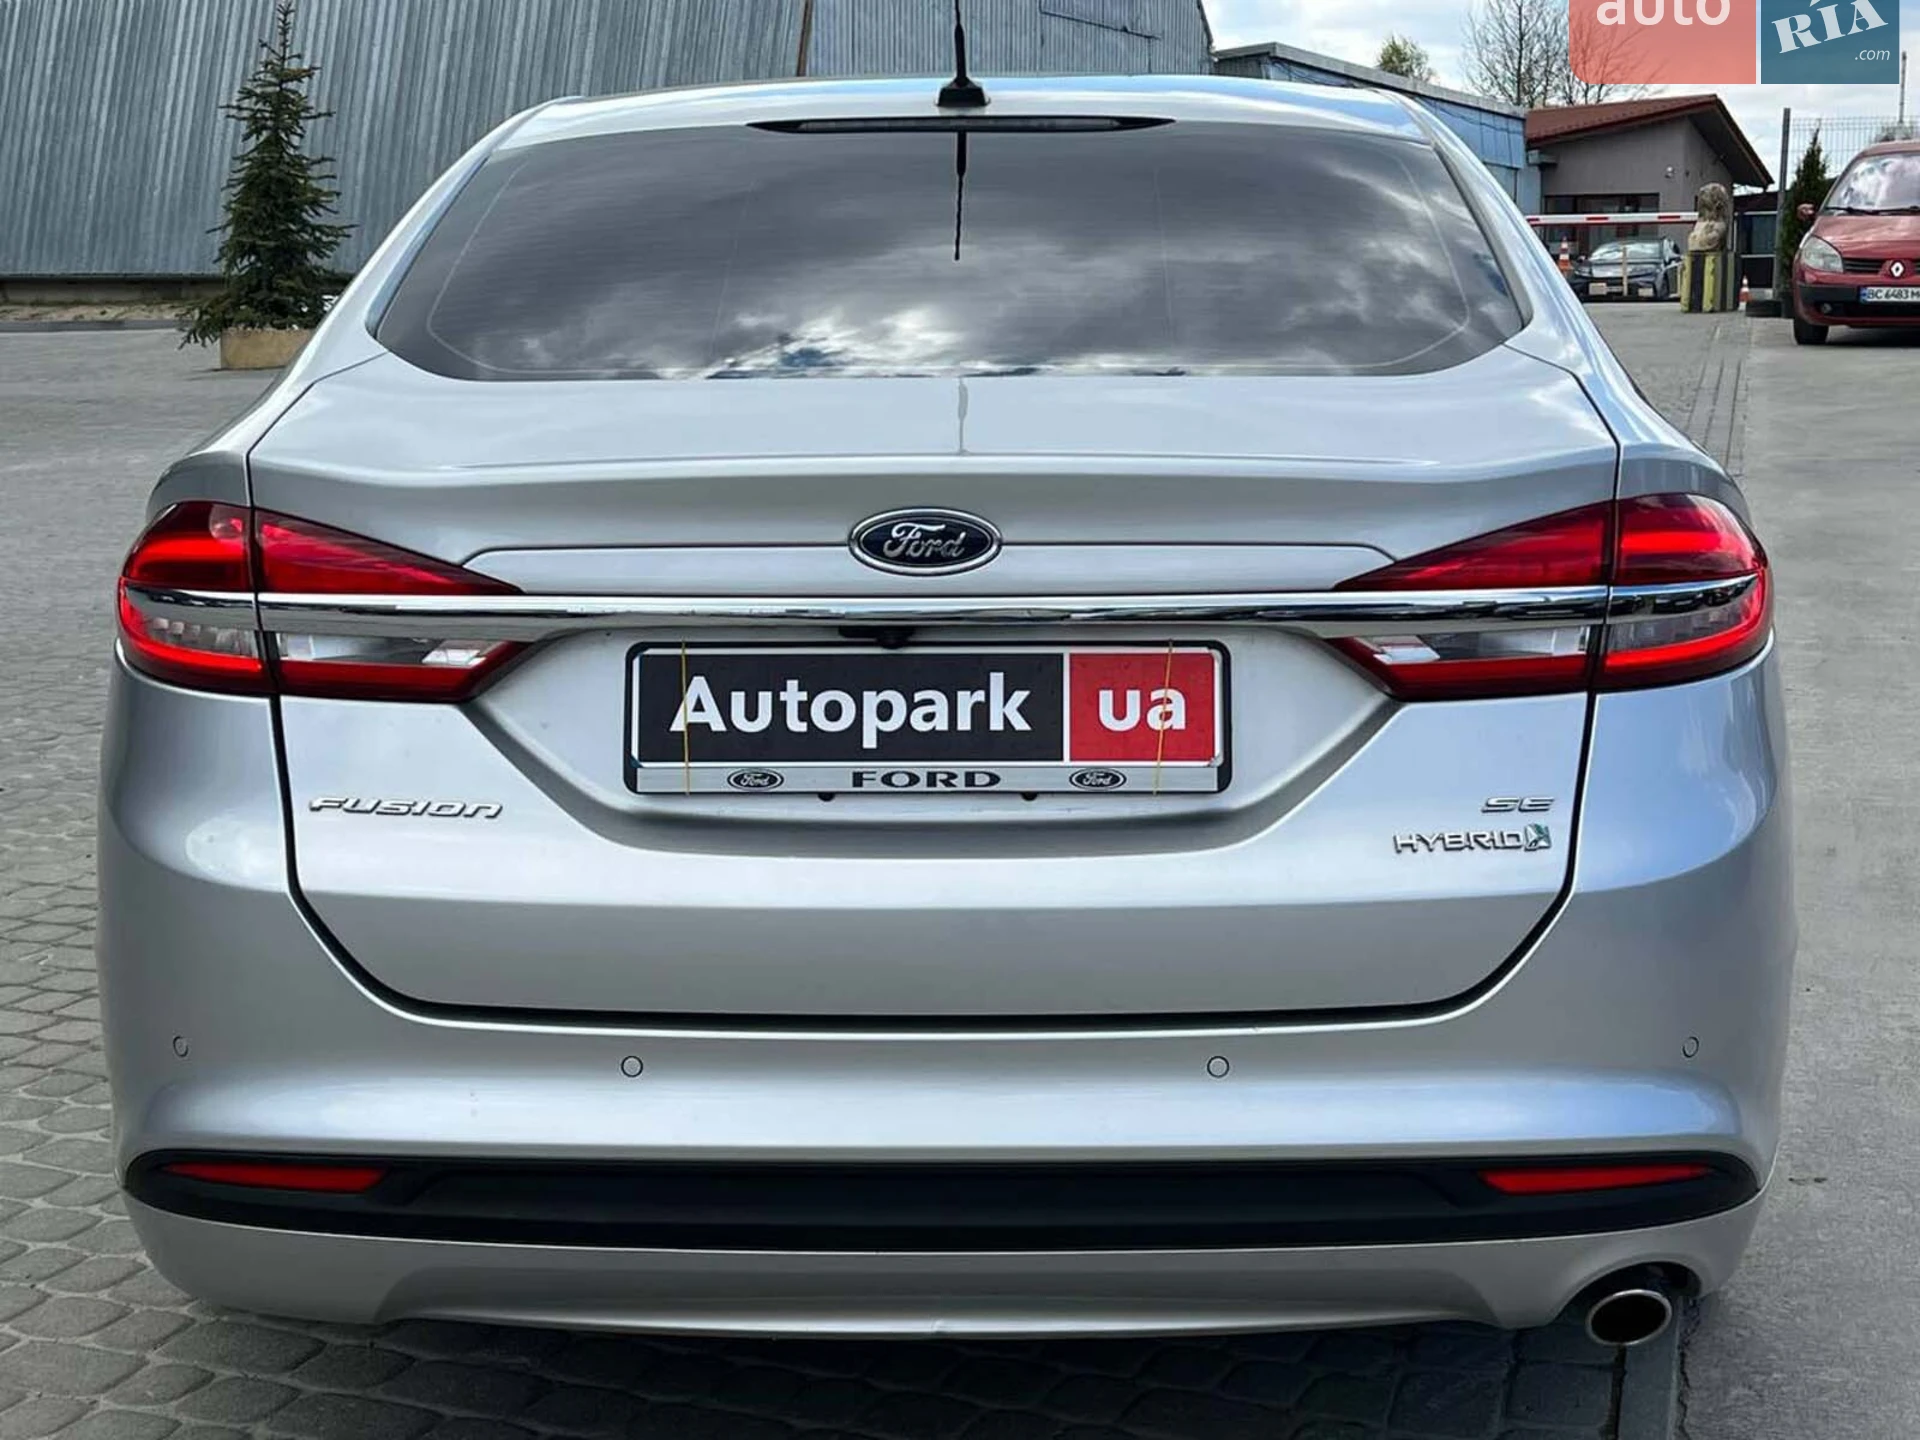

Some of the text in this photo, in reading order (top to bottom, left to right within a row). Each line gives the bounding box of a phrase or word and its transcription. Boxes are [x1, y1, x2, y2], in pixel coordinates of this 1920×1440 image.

[883, 522, 966, 558] Ford
[669, 672, 1187, 750] Autopark ua
[851, 770, 1001, 788] FORD
[309, 797, 503, 819] FUSION
[1481, 796, 1555, 813] SE
[1393, 829, 1524, 853] HYBRID
